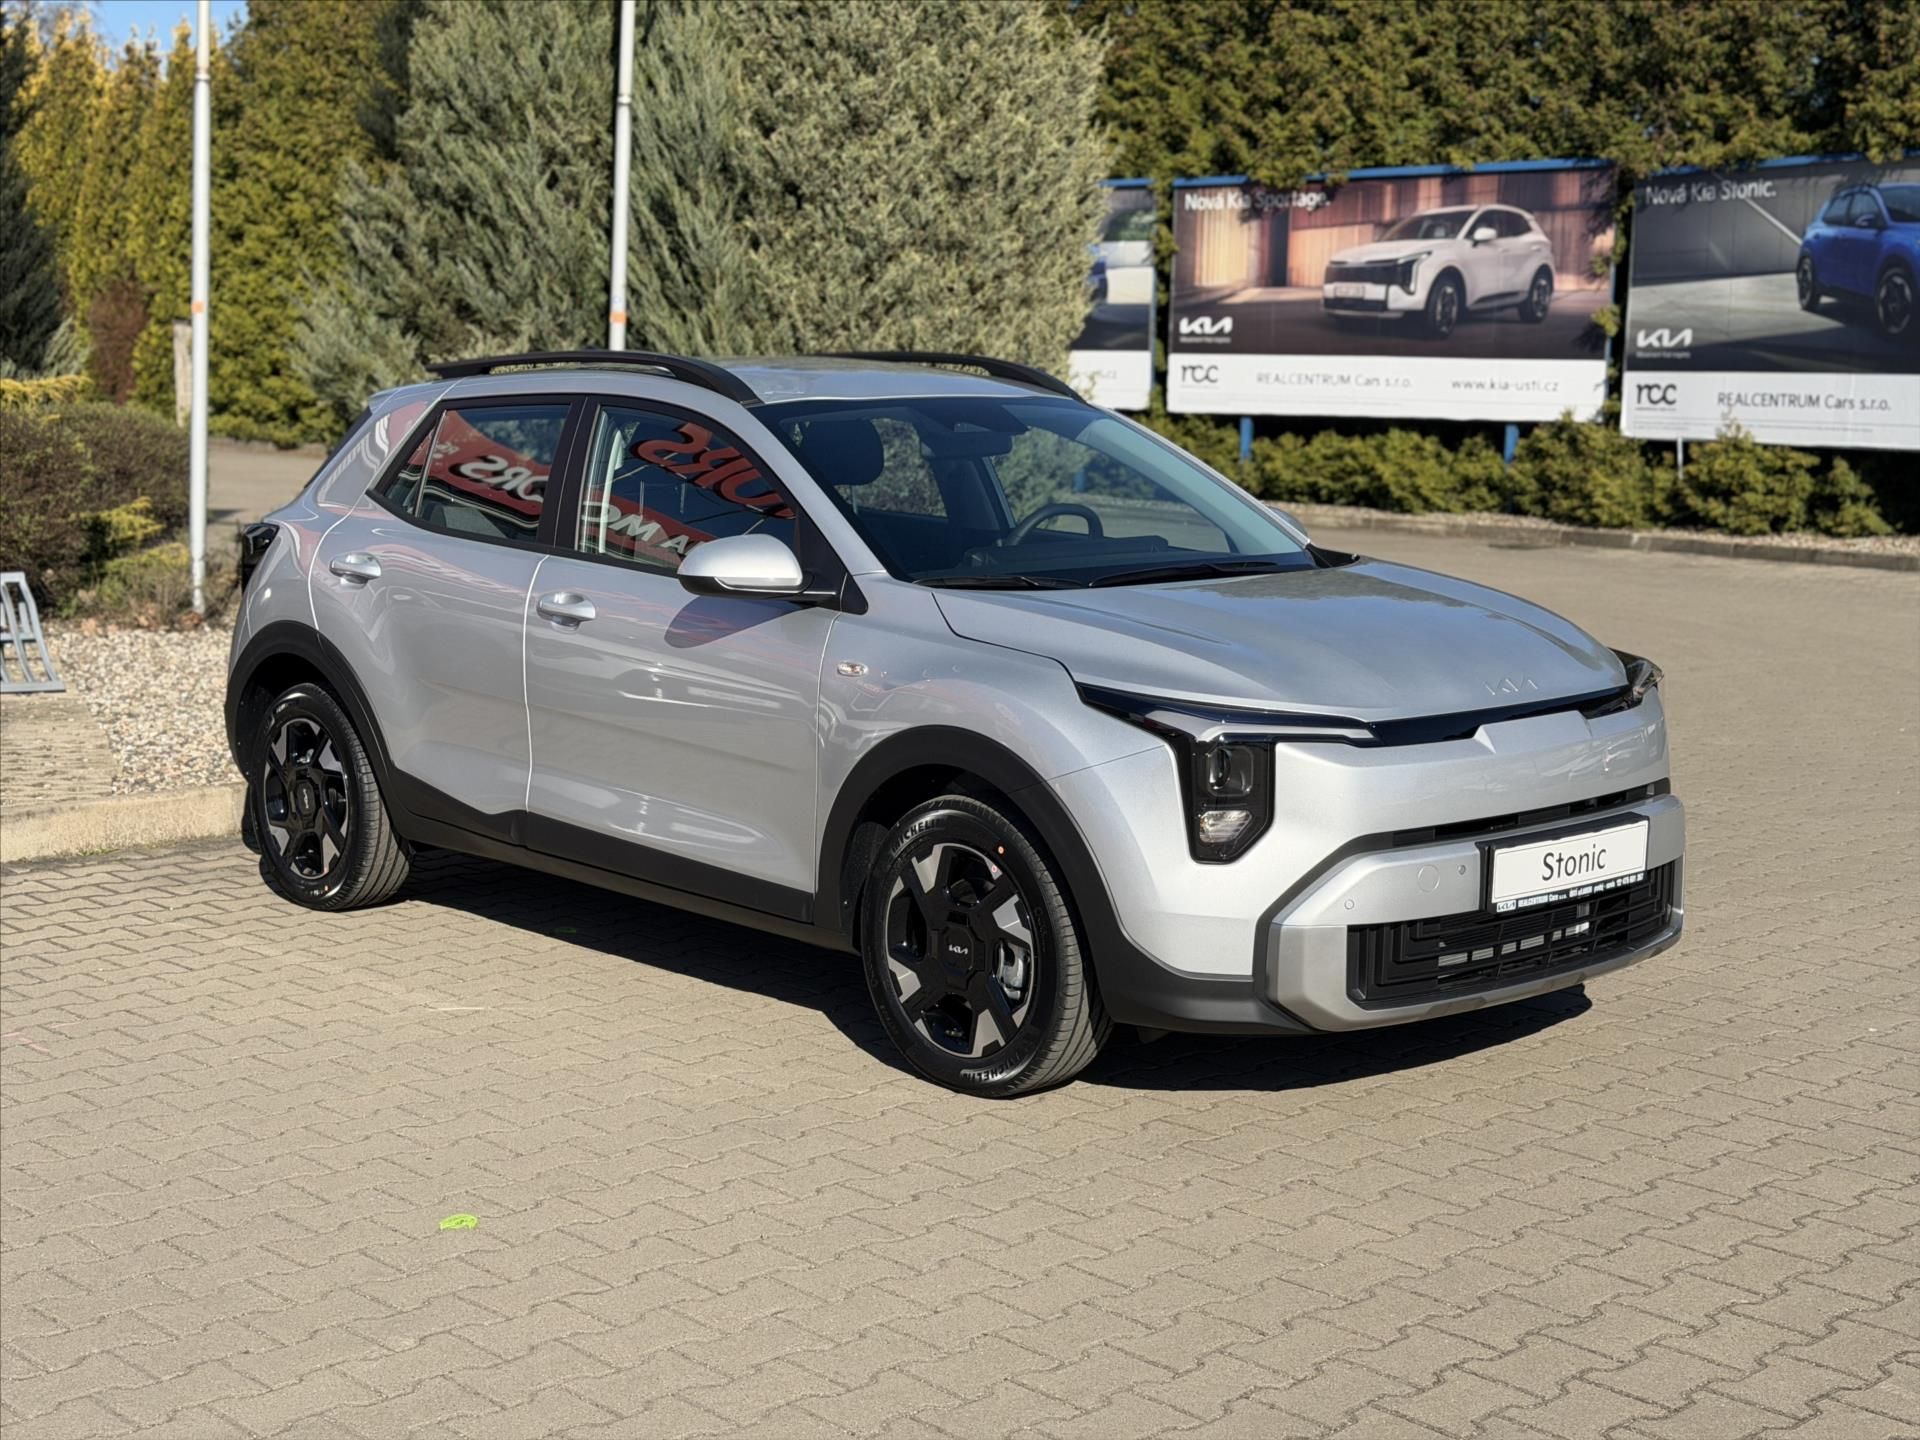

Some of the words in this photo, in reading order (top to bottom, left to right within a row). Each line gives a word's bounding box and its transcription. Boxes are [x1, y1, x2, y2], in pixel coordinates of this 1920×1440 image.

[1691, 181, 1716, 202] Kia
[1179, 316, 1233, 334] KIA
[1636, 328, 1693, 348] KIA
[1256, 372, 1351, 386] REALCENTRUM
[1717, 391, 1820, 409] REALCENTRUM
[1824, 394, 1855, 410] Cars
[1542, 843, 1607, 881] Stonic
